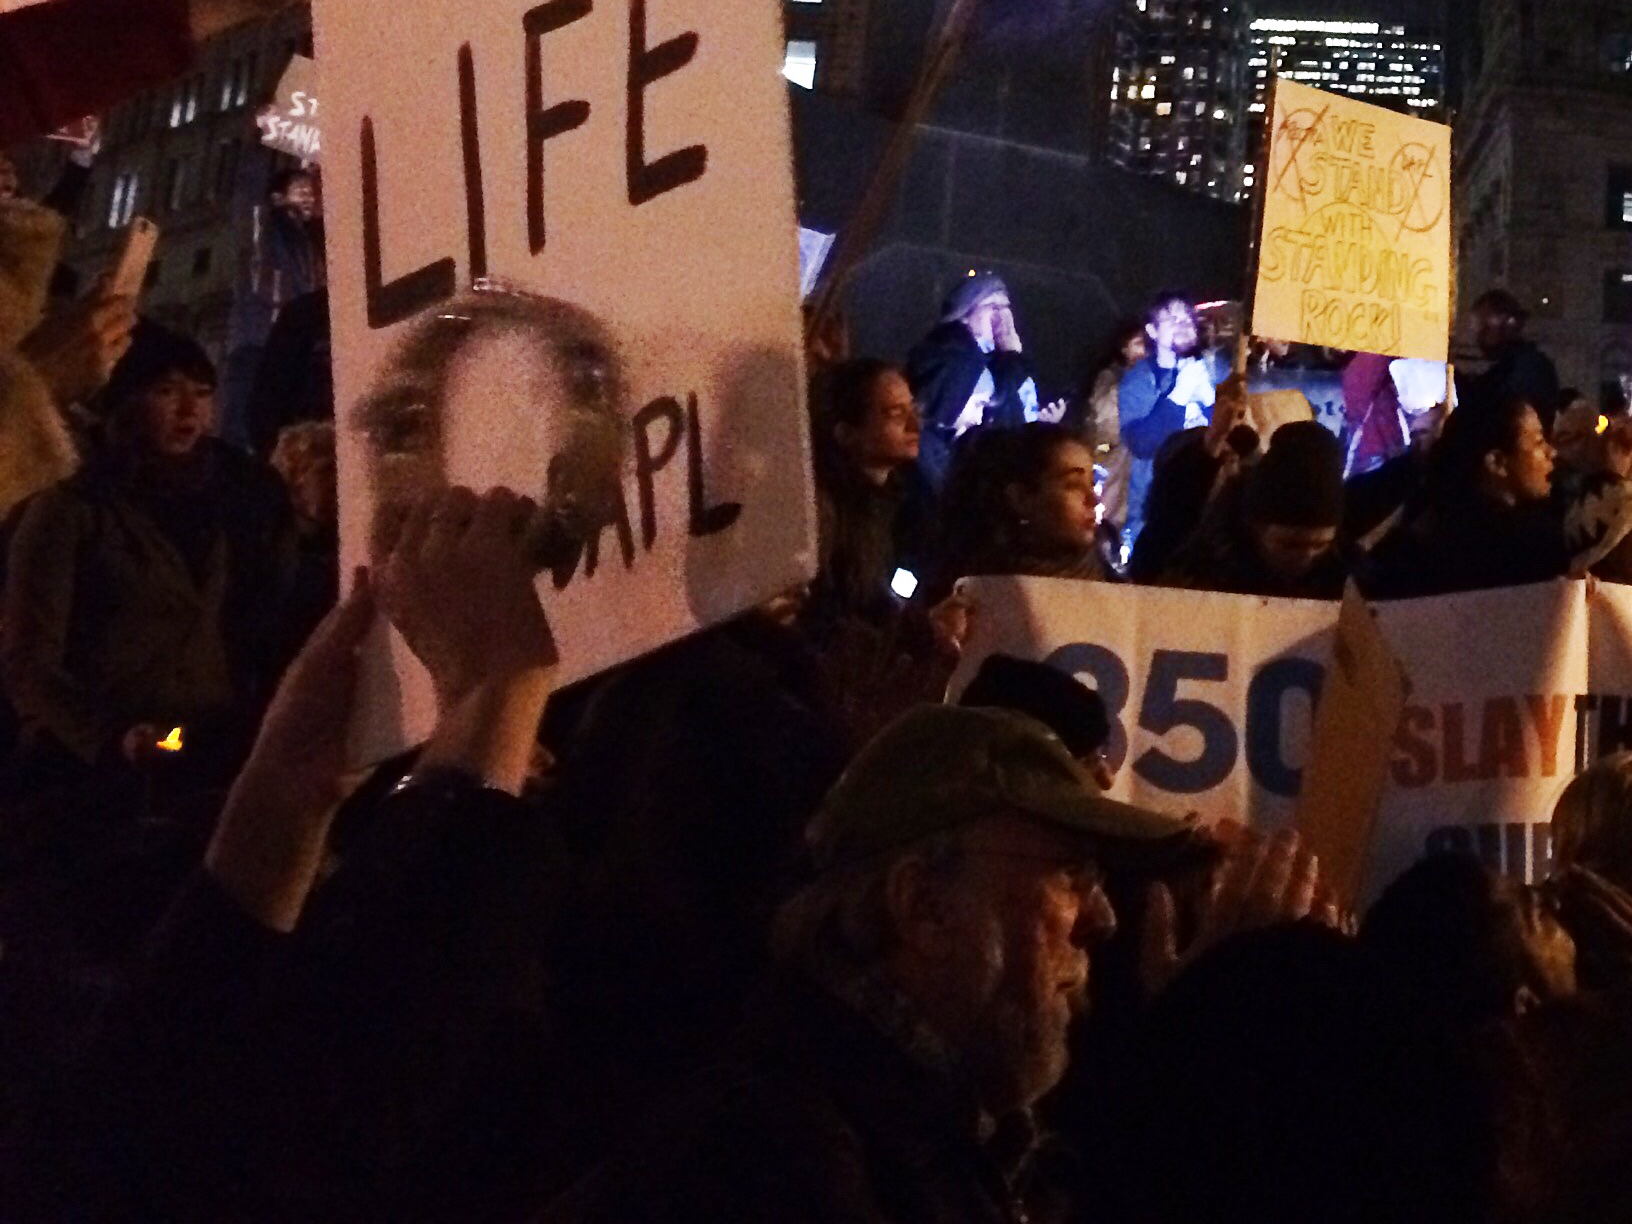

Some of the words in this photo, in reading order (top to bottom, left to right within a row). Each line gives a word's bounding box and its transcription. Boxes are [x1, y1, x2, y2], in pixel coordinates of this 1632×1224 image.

[1299, 150, 1409, 215] STAND
[1260, 225, 1439, 309] STANDING
[1392, 693, 1567, 787] SLAY
